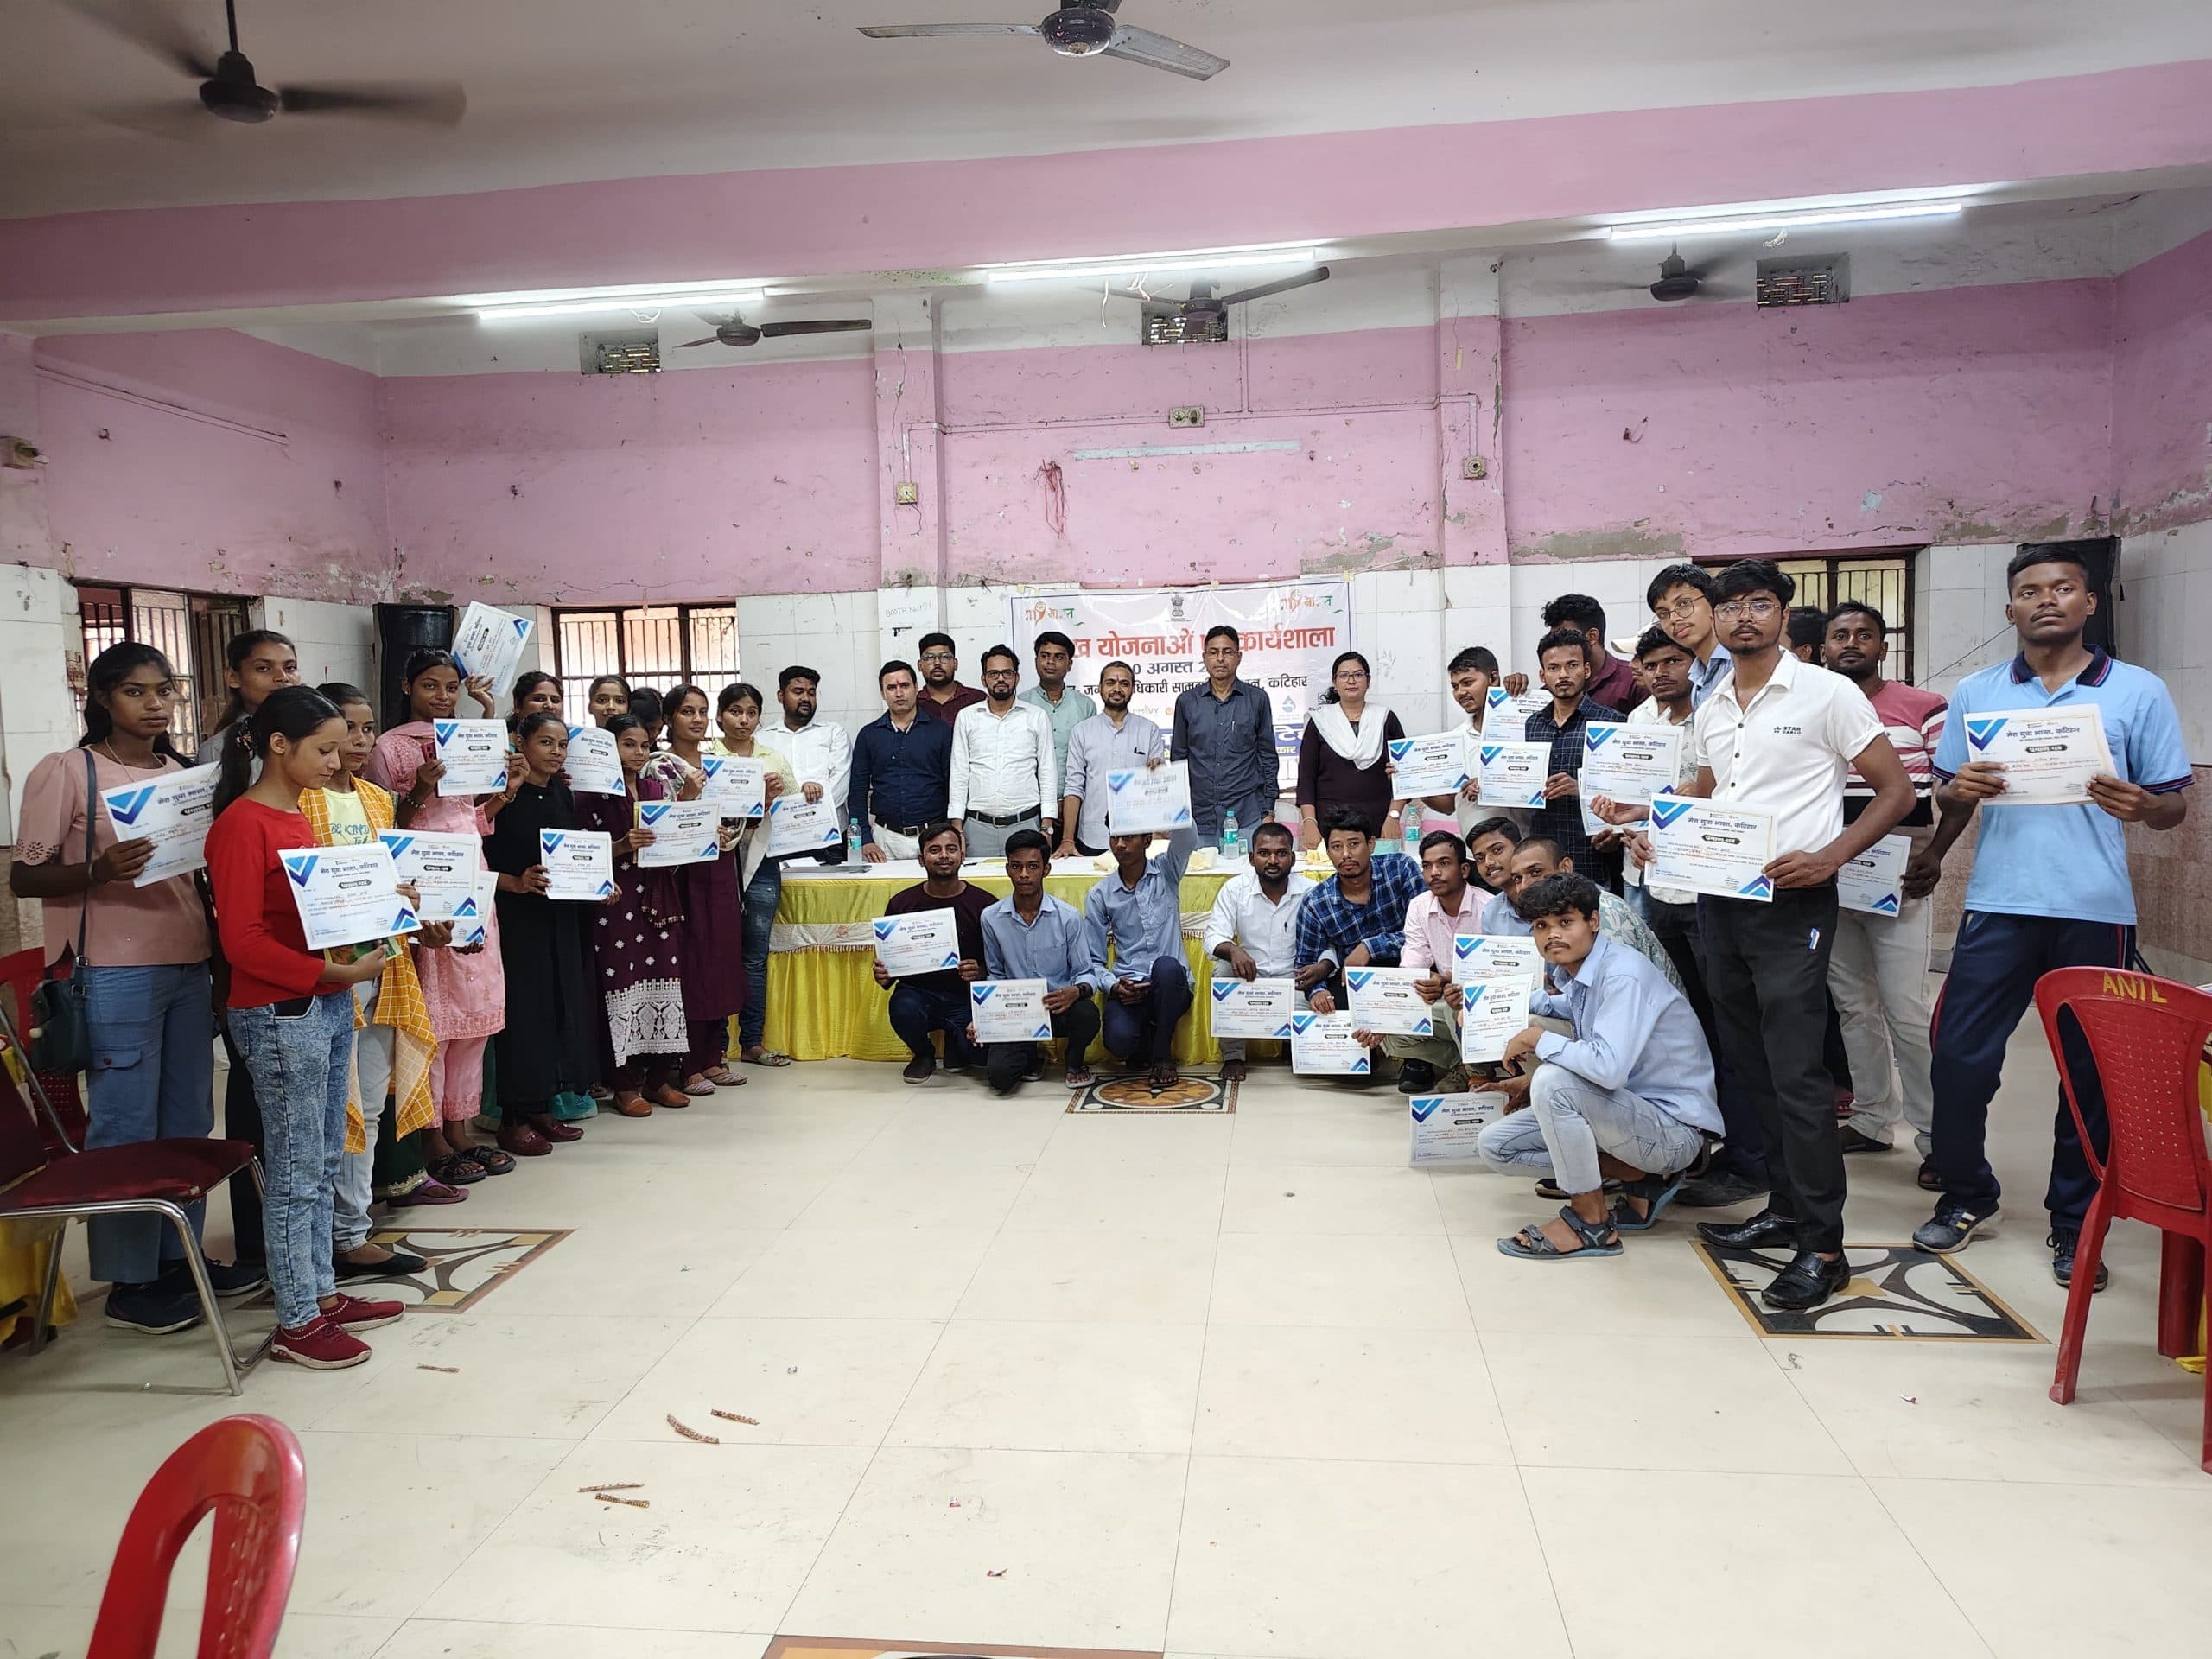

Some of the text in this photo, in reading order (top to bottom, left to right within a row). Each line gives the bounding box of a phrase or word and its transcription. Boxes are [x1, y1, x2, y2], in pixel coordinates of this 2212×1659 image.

[1096, 628, 1195, 658] योजनाओं
[1147, 661, 1194, 675] अगस्त
[1268, 673, 1308, 688] कटिहार
[345, 823, 370, 836] KIND
[2102, 971, 2168, 1004] ANIL
